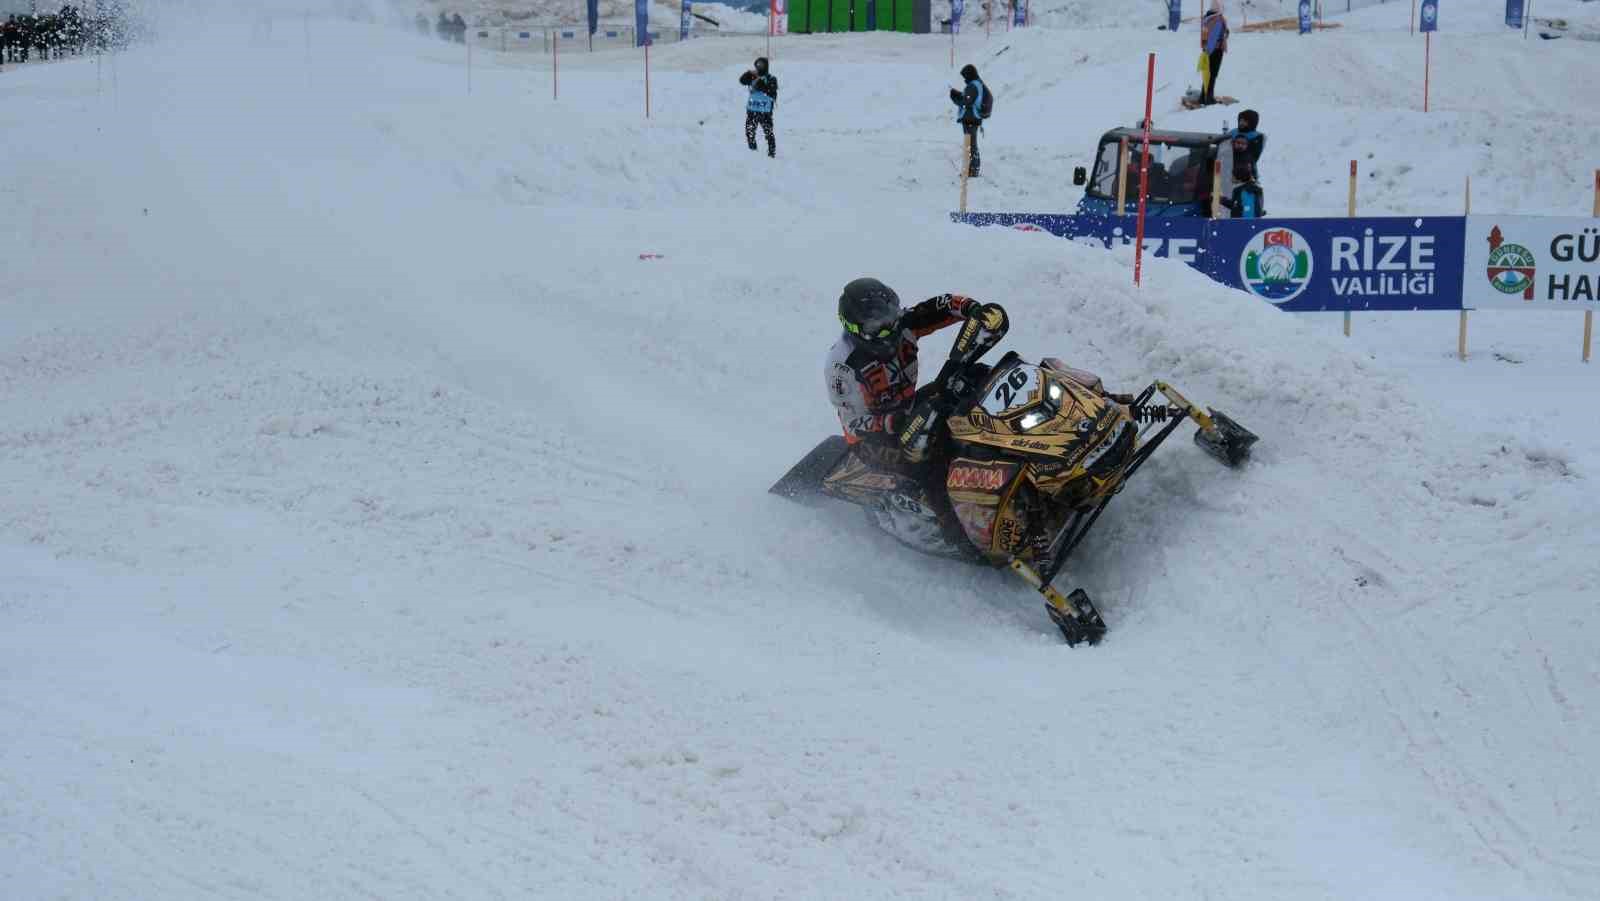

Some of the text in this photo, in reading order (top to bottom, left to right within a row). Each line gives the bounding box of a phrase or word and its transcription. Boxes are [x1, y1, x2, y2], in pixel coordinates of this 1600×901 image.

[1331, 228, 1436, 271] RİZE
[1550, 228, 1600, 263] GÜ
[1330, 272, 1434, 296] VALİLİĞİ
[1548, 274, 1600, 301] HA
[995, 367, 1029, 409] 26
